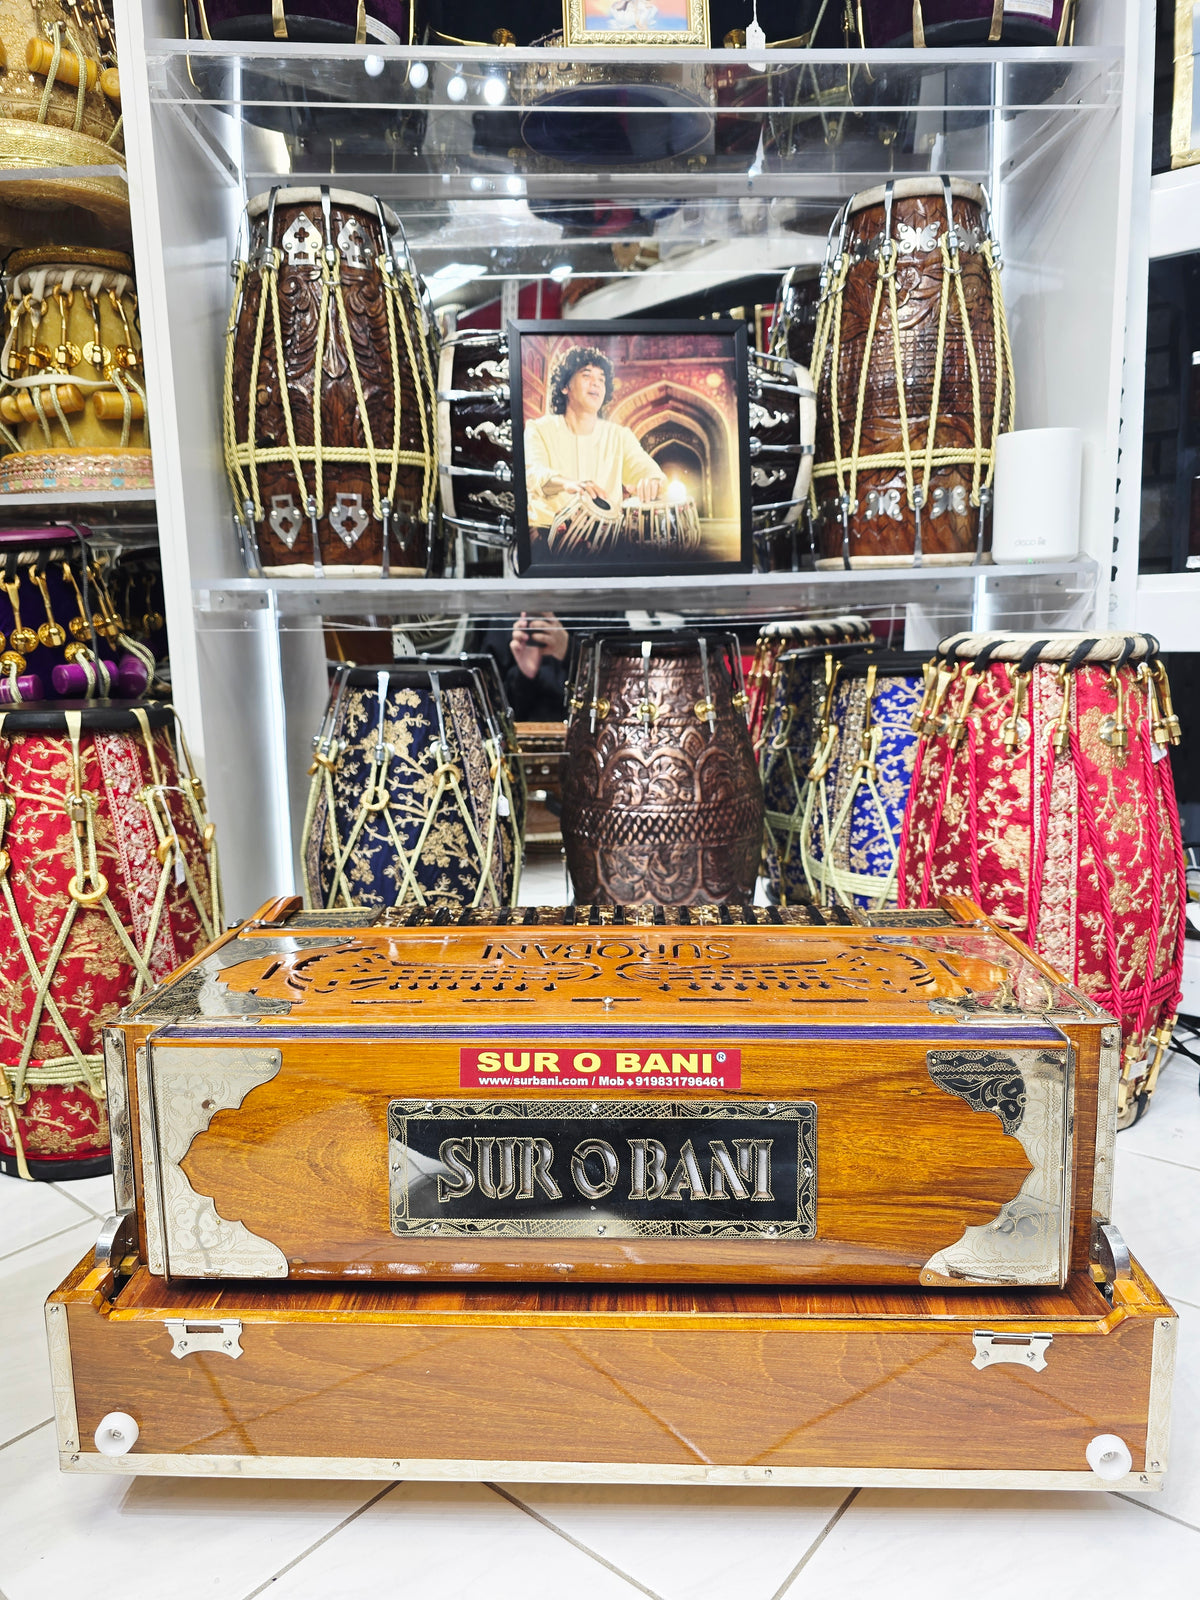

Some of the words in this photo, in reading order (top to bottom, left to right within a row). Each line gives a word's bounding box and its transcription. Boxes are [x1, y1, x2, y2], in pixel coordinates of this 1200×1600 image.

[476, 1051, 561, 1073] SUR
[573, 1052, 601, 1073] O
[437, 1137, 563, 1203] SUR
[570, 1138, 620, 1200] O
[627, 1139, 775, 1202] BANI
